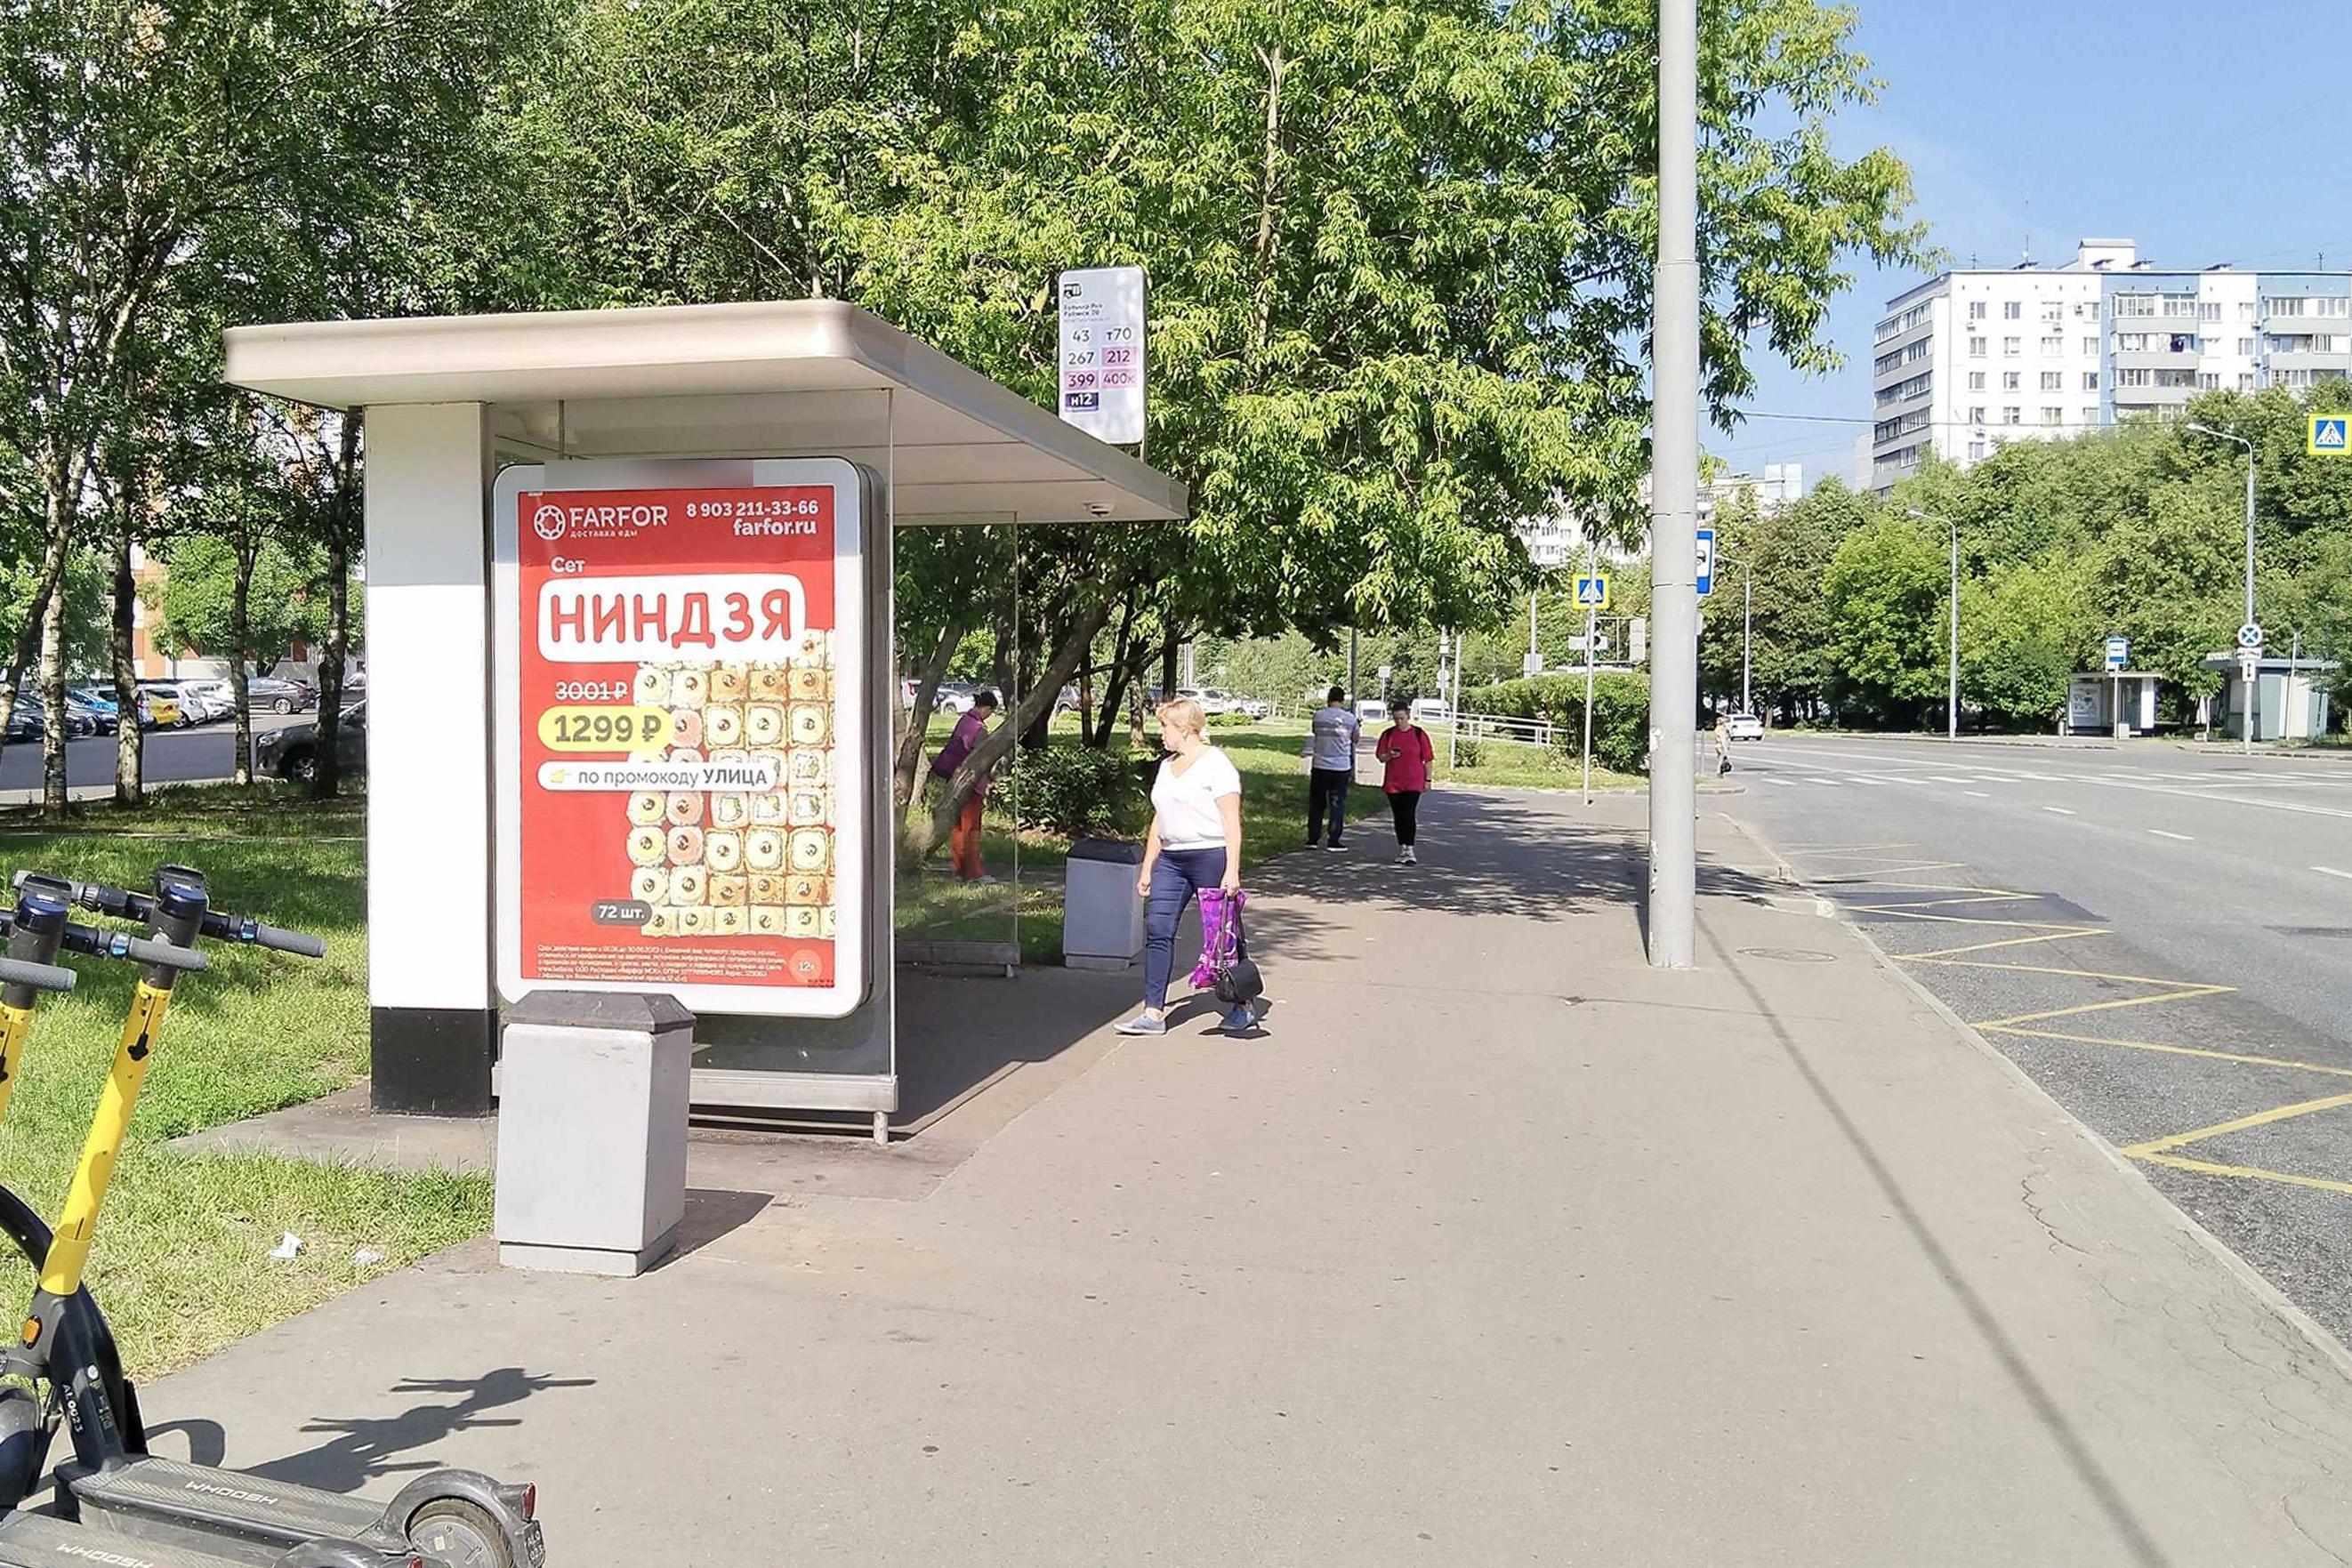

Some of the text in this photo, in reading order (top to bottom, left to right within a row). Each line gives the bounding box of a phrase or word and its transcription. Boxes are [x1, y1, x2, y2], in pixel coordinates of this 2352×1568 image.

[1072, 329, 1091, 342] 43
[1067, 350, 1131, 366] 267 212
[1067, 373, 1096, 388] 399
[568, 504, 668, 528] FARFOR
[686, 500, 819, 518] 8 903 211-33-66
[732, 517, 817, 535] farfor.ru
[550, 556, 585, 574] Сет
[550, 588, 792, 649] НИНДЗЯ
[554, 680, 611, 701] 3001
[554, 714, 634, 743] 1299
[578, 768, 768, 788] по промокоду УЛИЦА
[598, 904, 645, 920] 72 шт.
[184, 1480, 279, 1506] WHOOSH
[55, 1543, 154, 1568] WHOOSH
